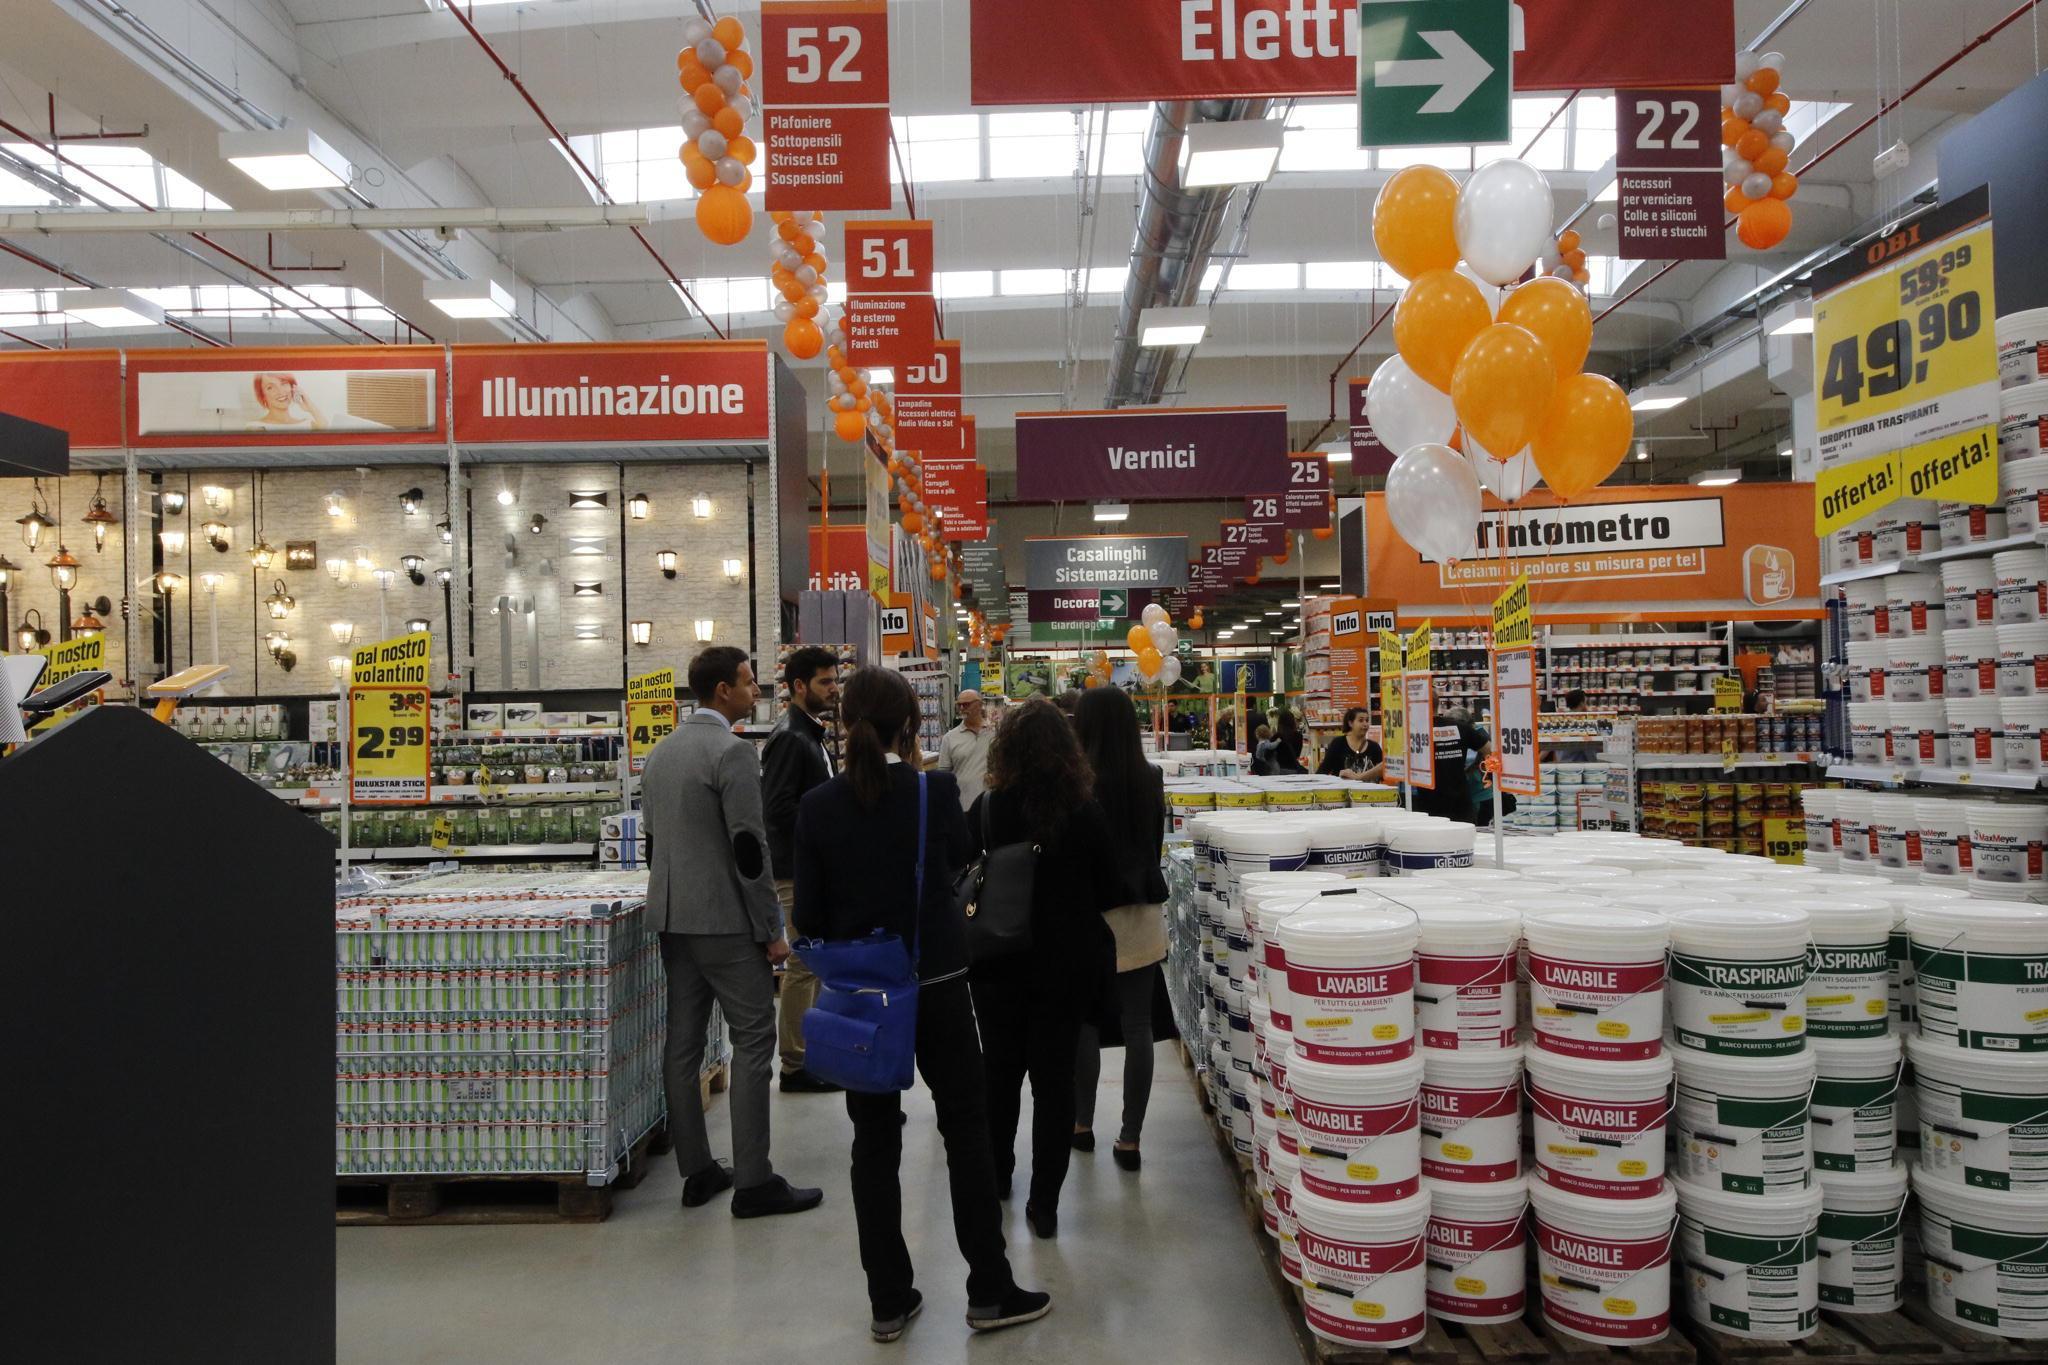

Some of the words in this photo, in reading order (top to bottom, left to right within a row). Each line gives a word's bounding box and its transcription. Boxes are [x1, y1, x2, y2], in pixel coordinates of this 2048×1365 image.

[787, 26, 862, 83] 52
[770, 116, 831, 129] Plafoniere
[1636, 100, 1699, 149] 22
[770, 134, 842, 149] Sottopensili
[771, 153, 813, 166] Strisce
[816, 153, 838, 165] LED
[771, 172, 843, 186] Sospensioni
[1622, 177, 1672, 189] Accessori
[1623, 196, 1641, 207] per
[1642, 193, 1693, 205] verniciare
[1624, 209, 1648, 221] Colle
[1652, 212, 1657, 221] e
[1660, 209, 1697, 221] siliconi
[1624, 226, 1659, 237] Polveri
[1661, 228, 1667, 237] e
[1670, 226, 1707, 237] stucchi
[1866, 224, 1921, 264] OBI
[862, 238, 915, 278] 51
[851, 300, 906, 310] Illuminazione
[851, 313, 862, 322] da
[863, 314, 895, 322] esterno
[851, 326, 867, 335] Pali
[869, 327, 875, 335] e
[876, 326, 899, 335] sfere
[851, 339, 879, 349] Faretti
[1822, 290, 1980, 407] 49,90
[907, 353, 947, 383] 50
[482, 375, 744, 417] Illuminazione
[898, 400, 932, 409] Lampadine
[930, 409, 956, 417] elettrici
[1820, 421, 1876, 446] IDROPITTURA
[1876, 402, 1940, 430] TRASPIRANTE
[1107, 443, 1196, 471] Vernici
[1910, 433, 1990, 496] Offerta!
[1291, 461, 1320, 483] 25
[1822, 462, 1894, 520] Offerta!
[1252, 499, 1277, 517] 26
[1227, 526, 1247, 542] 27
[1477, 512, 1671, 548] Tintometro
[1067, 545, 1147, 563] Casalinghi
[1524, 560, 1569, 576] colore
[1573, 560, 1591, 573] su
[1595, 555, 1645, 572] misura
[1648, 556, 1672, 570] per
[1676, 552, 1697, 567] te!
[1055, 566, 1159, 583] Sistemazione
[1493, 605, 1504, 623] Dal
[1505, 583, 1527, 616] nostro
[1336, 616, 1357, 632] Info
[1369, 614, 1392, 629] Info
[1495, 618, 1529, 645] volantino
[57, 640, 100, 665] nostro
[355, 647, 377, 666] Dal
[381, 639, 426, 662] nostro
[354, 663, 425, 682] volantino
[630, 678, 643, 689] Dal
[645, 672, 672, 687] nostro
[629, 687, 672, 700] volantino
[357, 726, 425, 759] 2,99
[633, 724, 673, 744] 4,95
[1501, 728, 1532, 756] 39,99
[1582, 820, 1610, 831] 15,99
[1323, 849, 1378, 864] IGIENIZZANTE
[1767, 841, 1808, 856] 19,90
[1545, 965, 1618, 989] LAVABILE
[1705, 963, 1804, 985] TRASPIRANTE
[1317, 975, 1388, 994] LAVABILE
[1300, 1106, 1364, 1131] LAVABILE
[1563, 1104, 1638, 1127] LAVABILE
[1307, 1238, 1371, 1269] LAVABILE
[1551, 1235, 1623, 1265] LAVABILE
[1857, 1241, 1892, 1251] TRASPIRANTE
[1752, 1267, 1794, 1277] TRASPIRANTE
[2002, 1264, 2047, 1273] TRASPIRANTE
